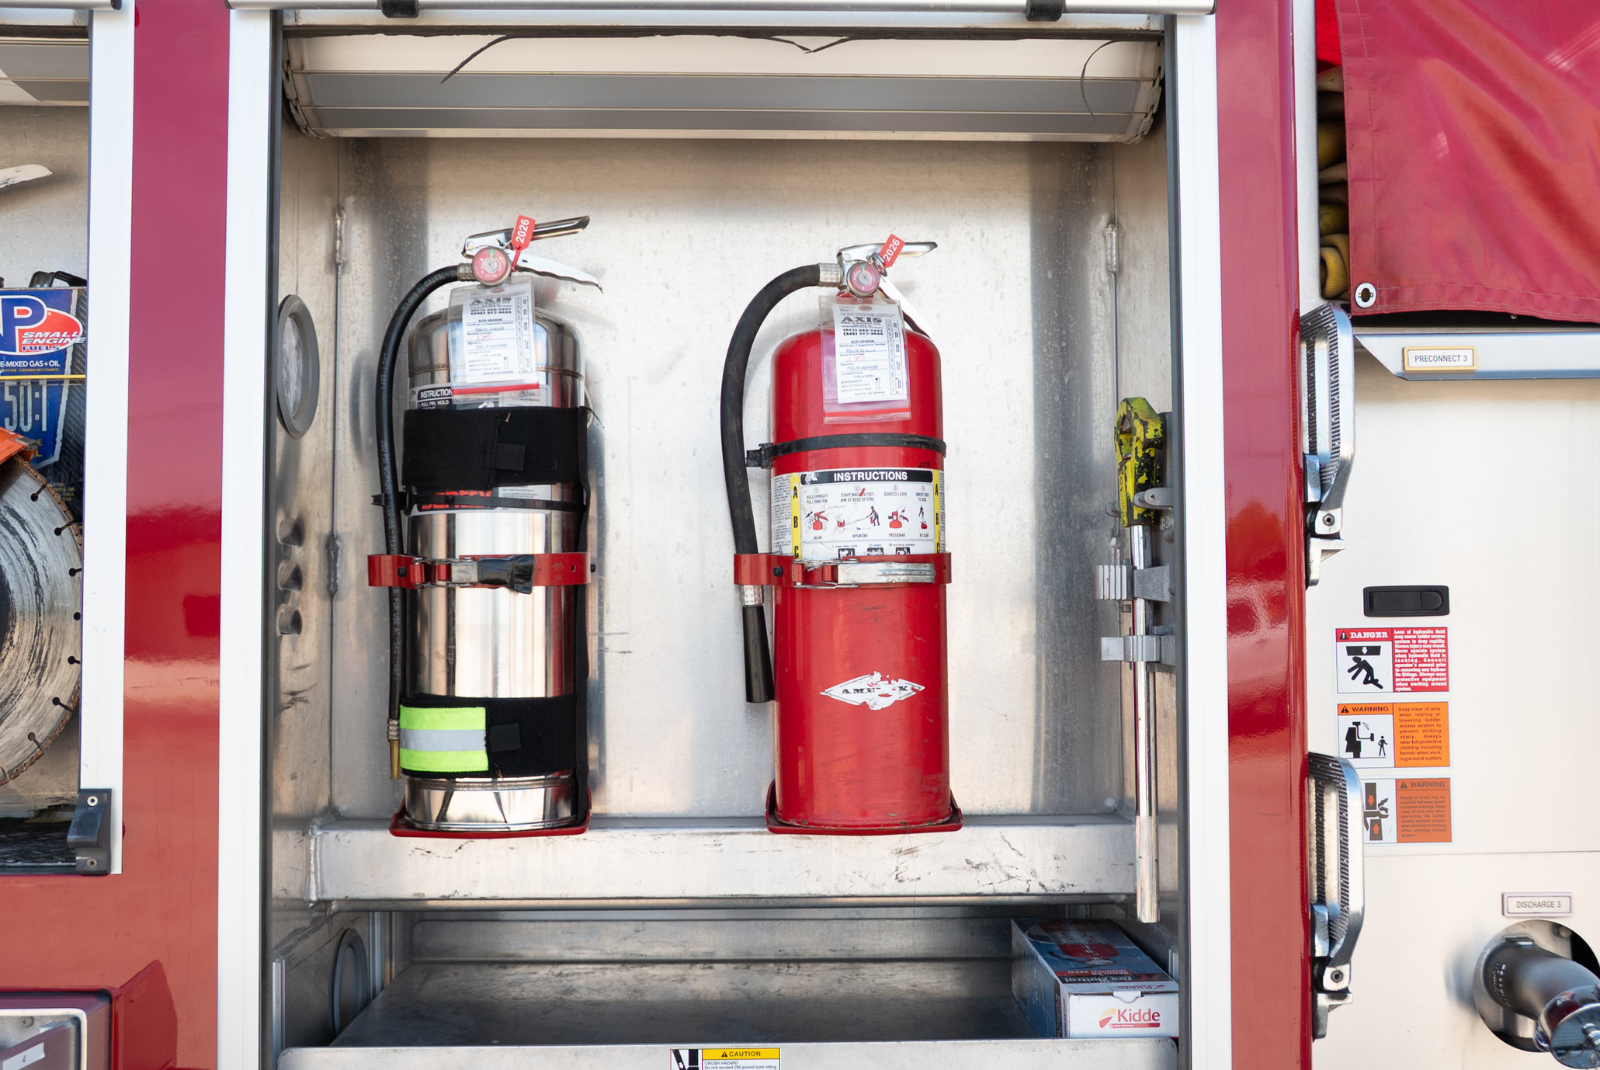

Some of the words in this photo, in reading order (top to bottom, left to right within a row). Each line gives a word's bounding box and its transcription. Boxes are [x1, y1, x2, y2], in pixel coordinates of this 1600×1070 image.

[515, 218, 530, 244] 2026
[883, 238, 900, 262] 2026
[0, 295, 47, 354] P
[420, 388, 452, 398] INSTRUCTION
[4, 380, 48, 432] 50:1
[384, 466, 392, 494] WORKING
[833, 471, 908, 482] INSTRUCTIONS
[793, 486, 798, 498] A
[935, 483, 938, 496] A
[793, 516, 798, 528] B
[936, 513, 939, 525] B
[794, 546, 799, 558] C
[1350, 631, 1388, 639] DANGER
[1117, 1008, 1160, 1022] Kidde
